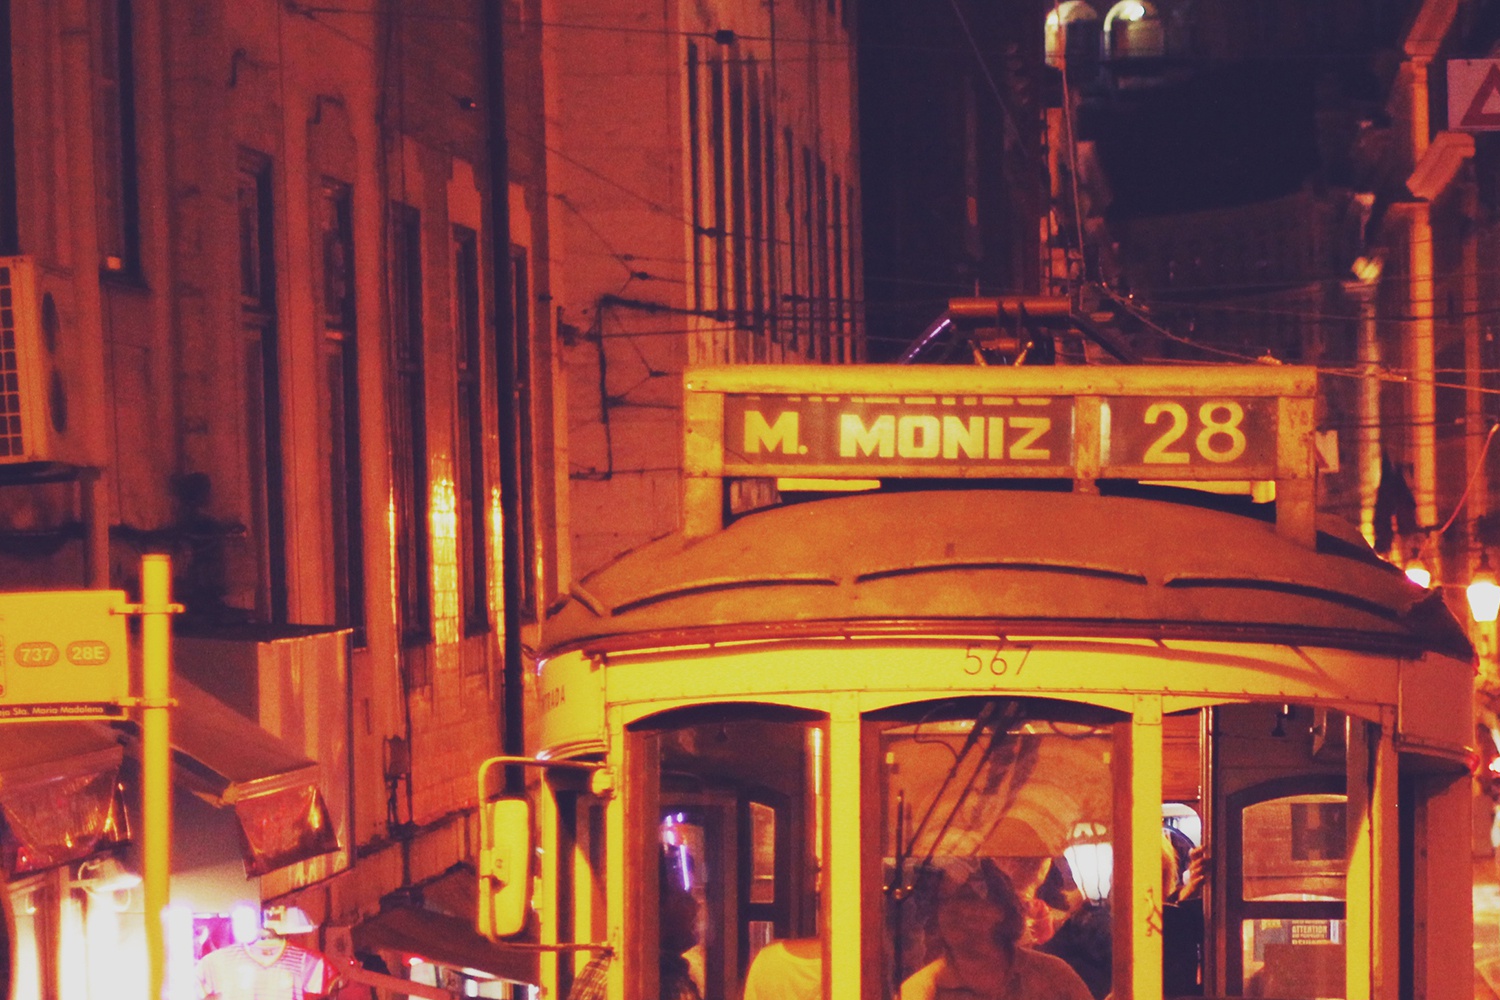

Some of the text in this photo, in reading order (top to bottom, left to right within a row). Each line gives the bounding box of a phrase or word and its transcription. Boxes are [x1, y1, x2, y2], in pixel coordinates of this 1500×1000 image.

[744, 410, 1051, 460] M. MONIZ
[1143, 401, 1246, 464] 28
[20, 645, 105, 662] 737 28E
[963, 643, 1034, 676] 567
[31, 705, 58, 715] Maria
